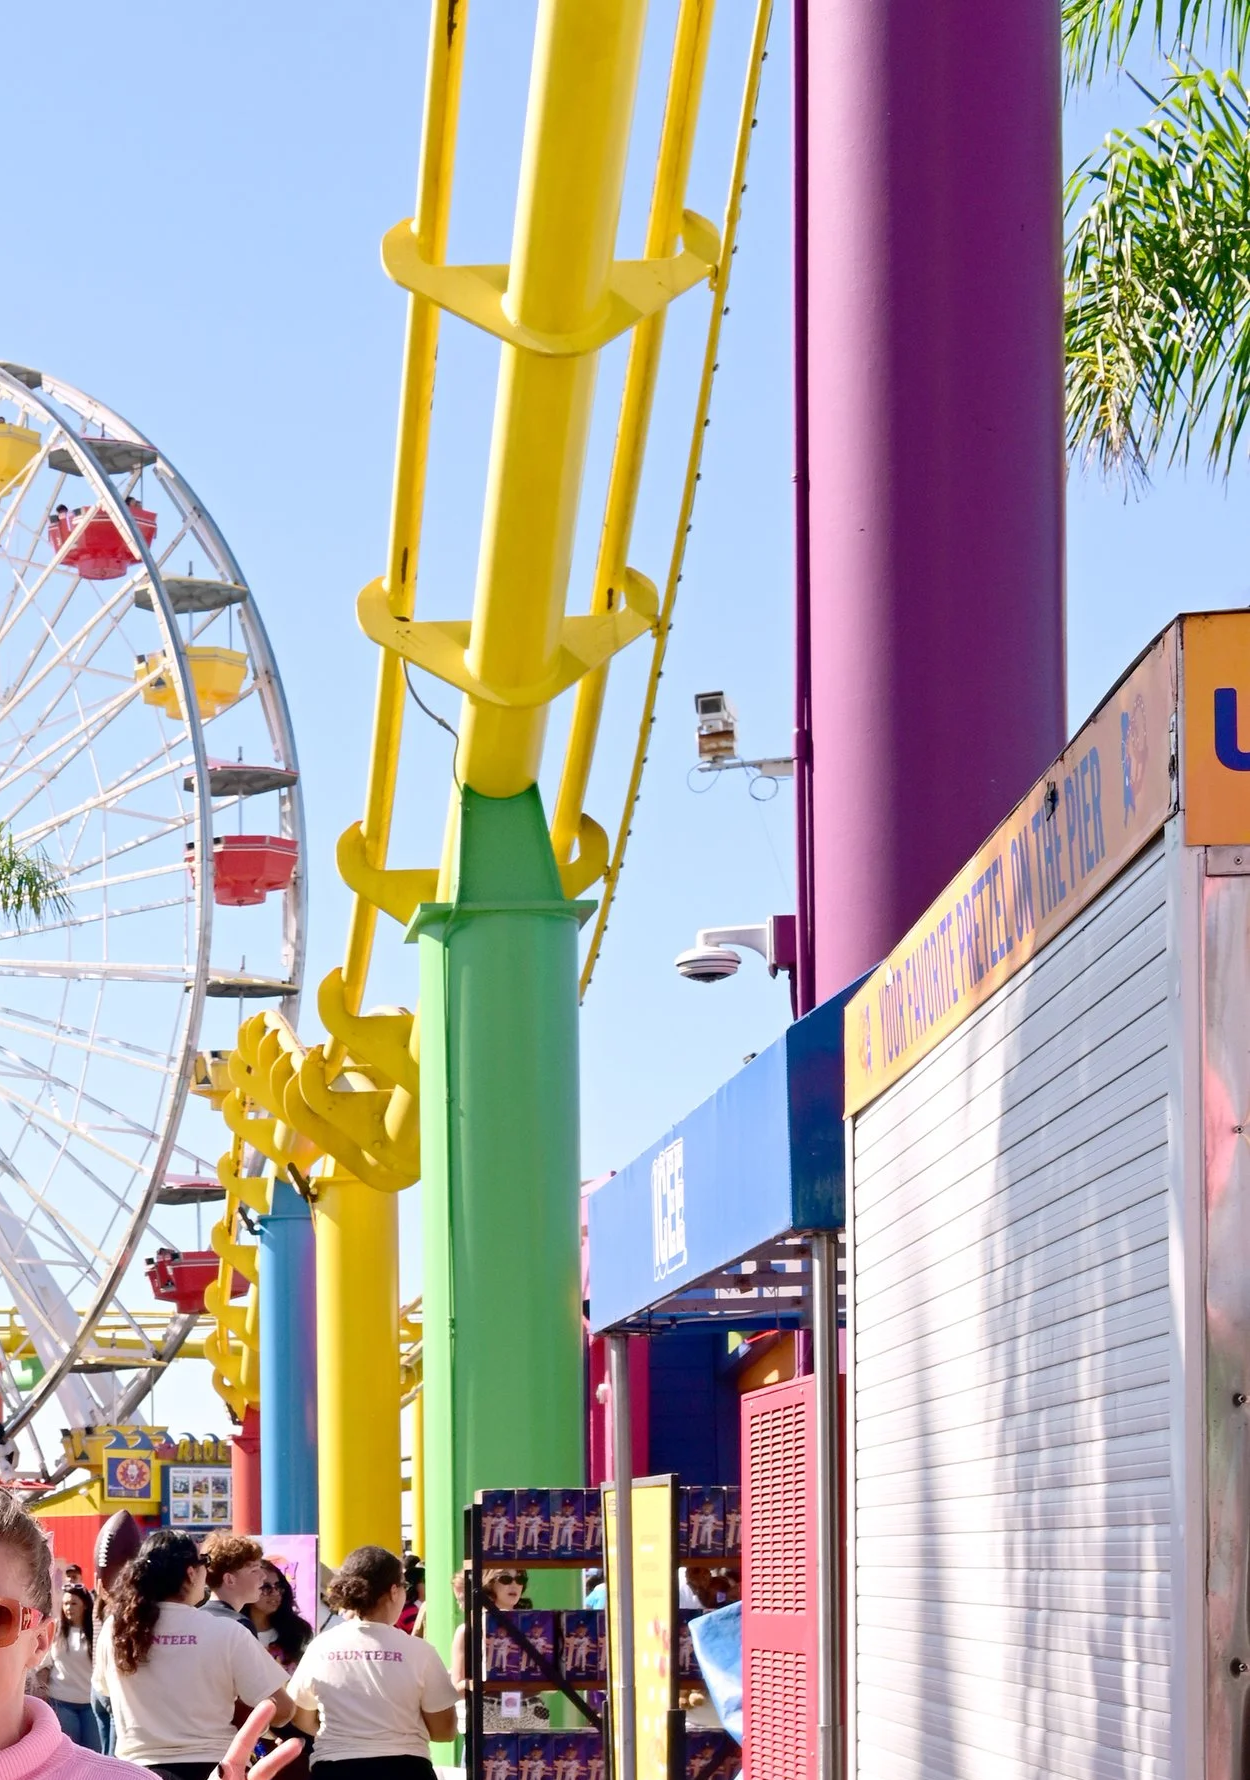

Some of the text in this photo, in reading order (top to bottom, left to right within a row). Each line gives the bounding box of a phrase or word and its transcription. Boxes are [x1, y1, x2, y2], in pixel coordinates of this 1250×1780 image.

[879, 746, 1105, 1068] YOUR FAVORITE PRETZEL ON THE PIER
[652, 1138, 687, 1278] ICEE
[151, 1635, 197, 1645] NTEER
[323, 1650, 403, 1662] OLUNTEER
